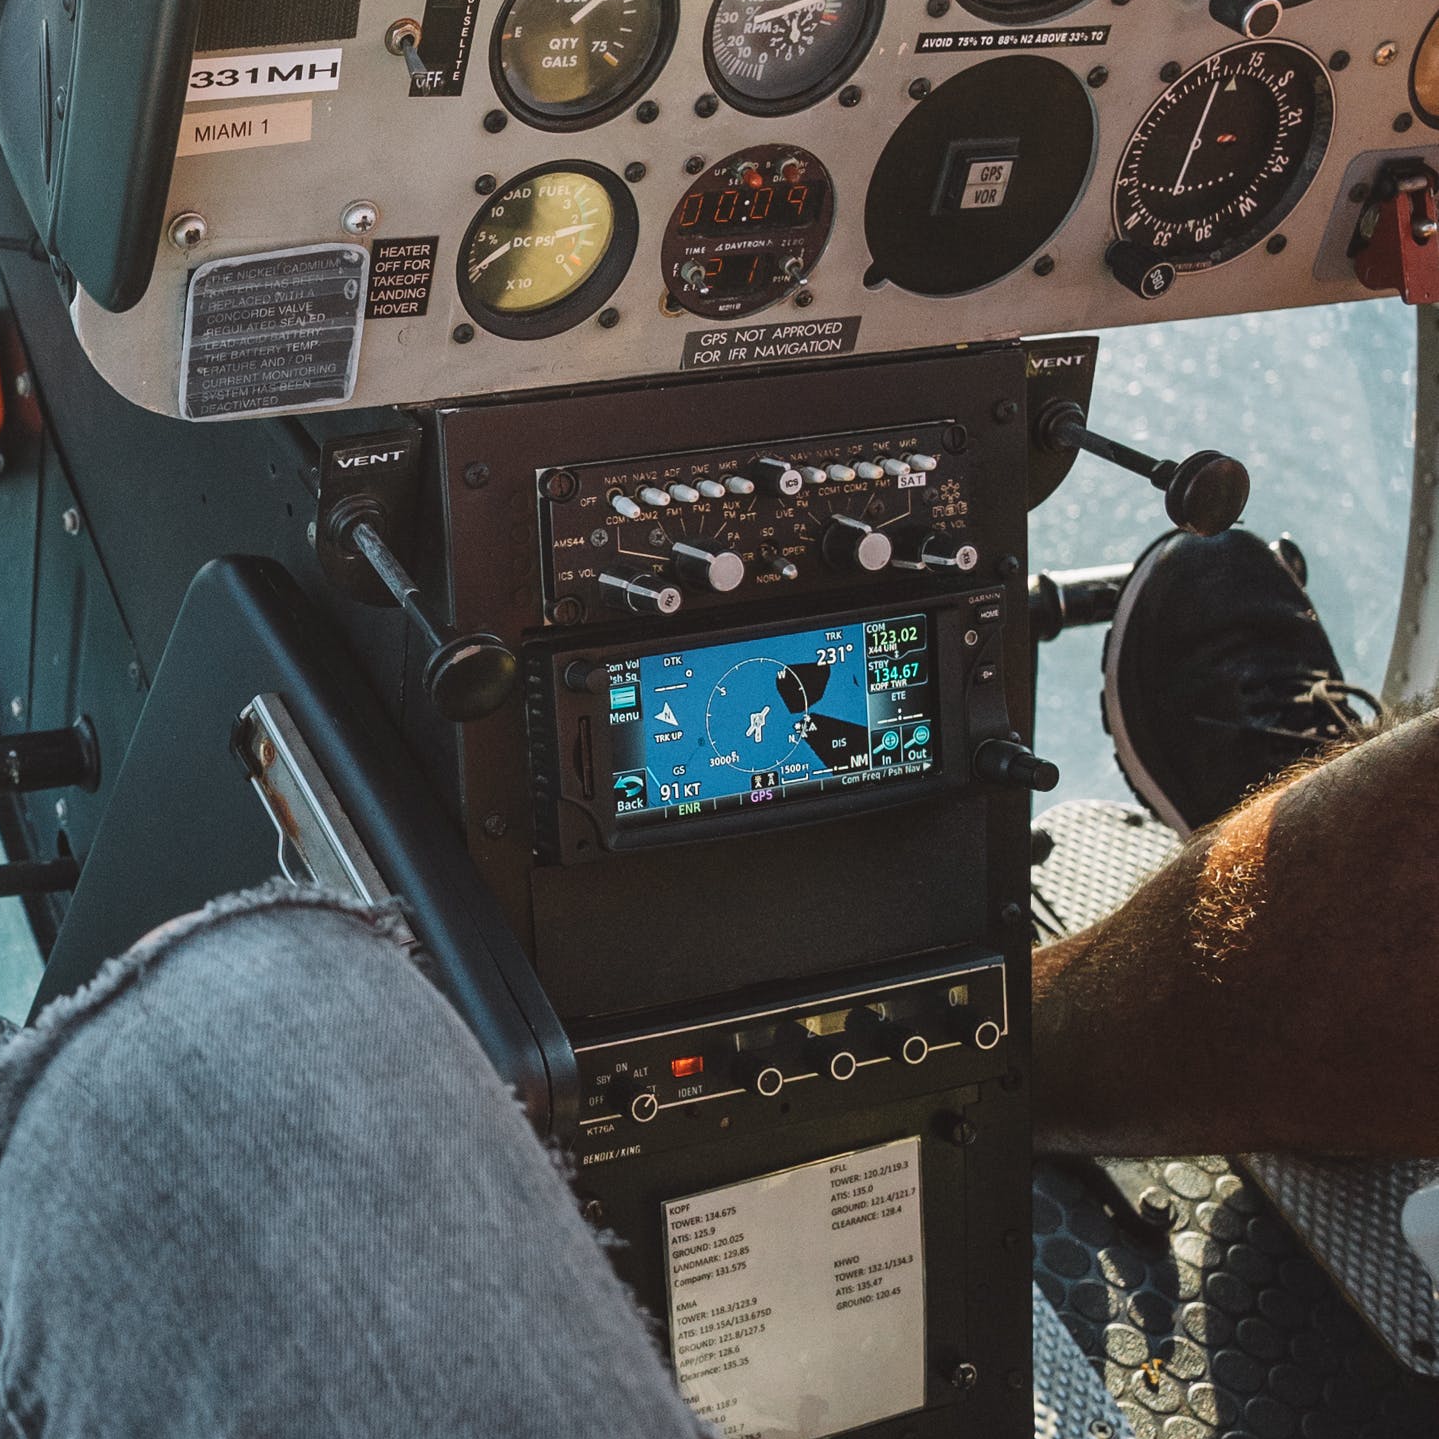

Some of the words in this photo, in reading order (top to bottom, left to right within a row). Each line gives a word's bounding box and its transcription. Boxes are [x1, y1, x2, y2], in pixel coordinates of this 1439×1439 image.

[743, 23, 772, 34] RPM
[549, 37, 579, 50] QTY
[922, 38, 953, 48] AVOID
[957, 37, 977, 47] 75%
[980, 36, 994, 45] TO
[1019, 34, 1033, 44] N2
[1034, 32, 1068, 44] ABOVE
[542, 56, 578, 68] GALS
[190, 62, 338, 88] 331MH
[195, 120, 253, 143] MIAMI
[261, 119, 269, 134] 1
[981, 165, 1004, 182] GPS
[538, 185, 571, 197] FUEL
[974, 189, 997, 204] VOR
[513, 237, 532, 247] DC
[534, 235, 555, 247] PSI
[380, 244, 431, 258] HEATER
[685, 246, 706, 256] TIME
[375, 262, 399, 273] OFF
[403, 259, 431, 271] FOR
[372, 273, 429, 287] TAKEOFF
[370, 288, 426, 302] LANDING
[373, 302, 418, 316] HOVER
[700, 332, 727, 347] GPS
[734, 328, 766, 343] NOT
[771, 322, 843, 340] APPROVED
[693, 351, 720, 364] FOR
[728, 348, 747, 361] IFR
[754, 339, 842, 358] NAVIGATION
[1030, 355, 1085, 369] VENT
[337, 450, 405, 468] VENT
[664, 467, 681, 478] ADF
[691, 463, 710, 474] DME
[785, 477, 799, 489] ICS
[899, 474, 924, 487] SAT
[580, 496, 598, 508] OFF
[552, 537, 585, 549] AMS44
[558, 571, 574, 582] ICS
[578, 568, 597, 579] VOL
[866, 623, 886, 633] COM
[825, 631, 842, 641] TRK
[872, 626, 918, 647] 123.02
[663, 656, 683, 667] DTK
[816, 644, 853, 666] 231°
[868, 660, 890, 671] STBY
[873, 662, 919, 682] 134.67
[890, 678, 908, 688] TWR
[891, 691, 906, 701] ETE
[610, 711, 640, 724] Menu
[654, 733, 670, 743] TRK
[671, 731, 683, 741] UP
[831, 738, 847, 749] DIS
[850, 753, 869, 768] NM
[882, 754, 892, 765] In
[908, 748, 927, 760] Out
[672, 766, 686, 776] GS
[841, 774, 860, 785] Com
[862, 771, 880, 783] Freq
[888, 766, 904, 777] Psh
[905, 764, 921, 774] Nav
[660, 783, 679, 801] 91
[684, 782, 701, 796] KT
[750, 789, 773, 803] GPS
[617, 798, 644, 812] Back
[678, 803, 701, 816] ENR
[616, 1061, 628, 1073] ON
[633, 1067, 648, 1079] ALT
[596, 1074, 612, 1086] SBY
[678, 1084, 704, 1098] IDENT
[588, 1096, 605, 1107] OFF
[587, 1124, 615, 1136] KT76A
[583, 1144, 641, 1165] BENDIX/KING
[830, 1173, 862, 1188] TOWER:
[669, 1203, 690, 1216] KOPF
[670, 1216, 704, 1230] TOWER:
[705, 1206, 737, 1222] 134.675
[671, 1233, 692, 1245] ATIS:
[694, 1226, 716, 1239] 125.9
